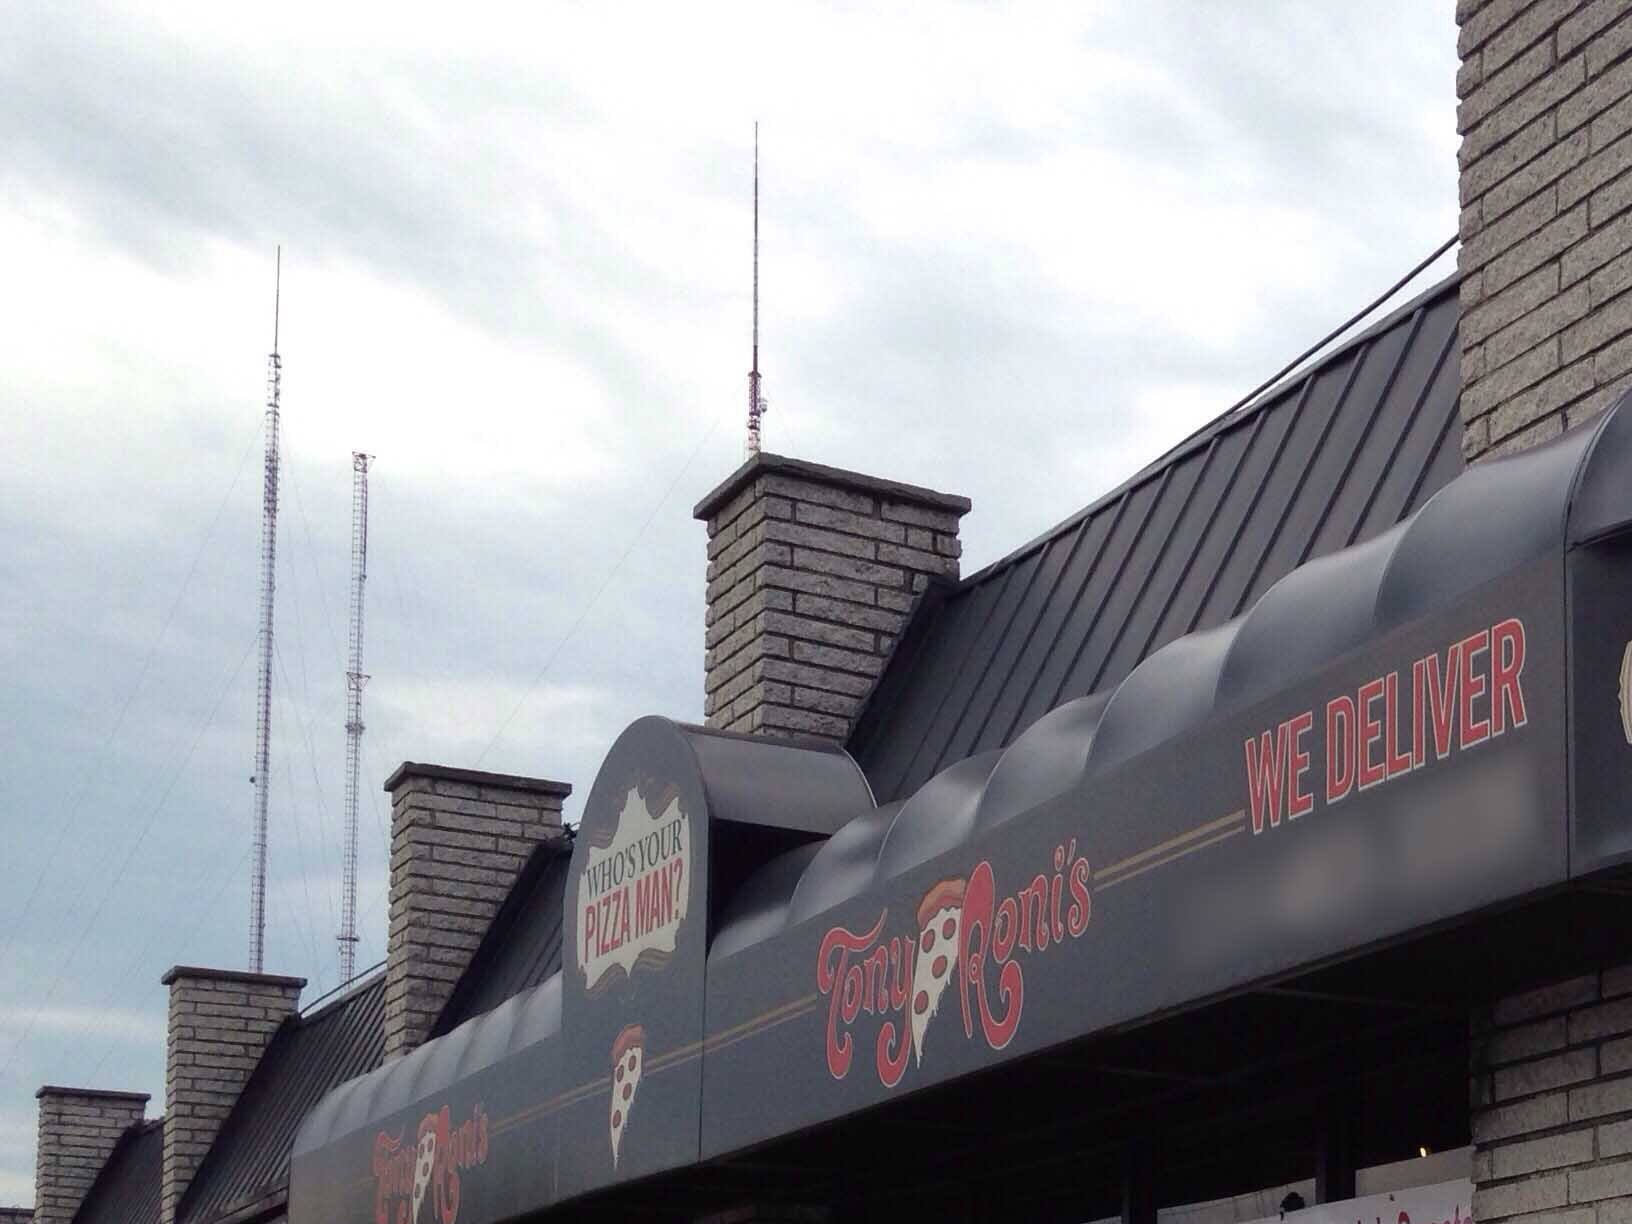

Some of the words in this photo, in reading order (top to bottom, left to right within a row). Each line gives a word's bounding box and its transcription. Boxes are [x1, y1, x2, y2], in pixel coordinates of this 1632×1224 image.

[1244, 711, 1314, 835] WE
[1326, 617, 1528, 806] DELIVER
[584, 885, 631, 963] PIZZA
[634, 857, 684, 939] MAN?
[586, 843, 636, 899] WHO'S
[637, 818, 683, 873] YOUR
[817, 907, 916, 1089] Tony
[959, 839, 1091, 1050] Roni's
